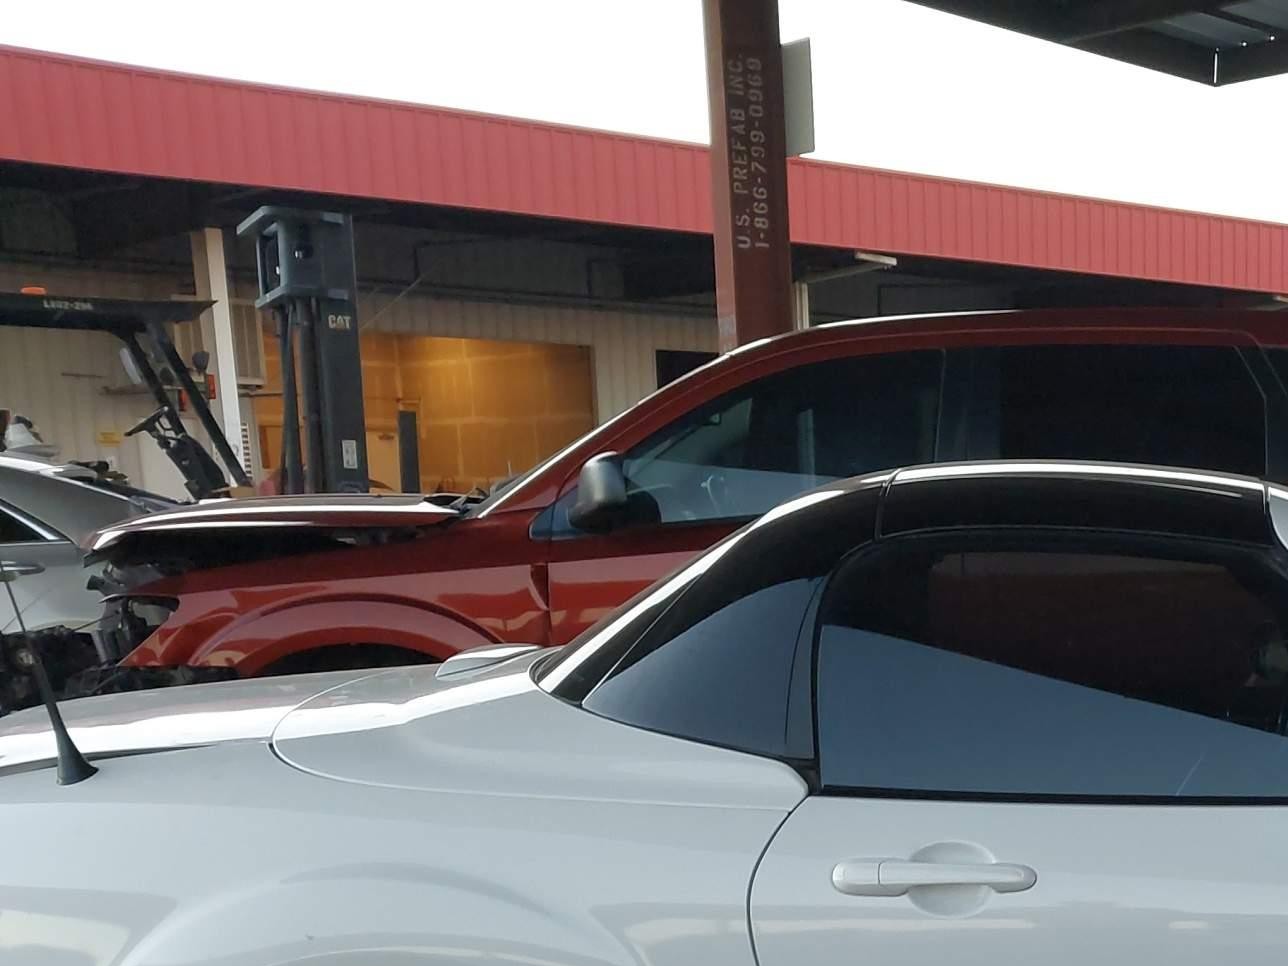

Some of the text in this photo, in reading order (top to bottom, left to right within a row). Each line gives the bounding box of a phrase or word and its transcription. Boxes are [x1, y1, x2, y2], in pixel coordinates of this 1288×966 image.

[727, 53, 752, 249] U.S. PREFAB INC.
[746, 57, 770, 249] 1-866-799-0969
[327, 314, 352, 329] CAT
